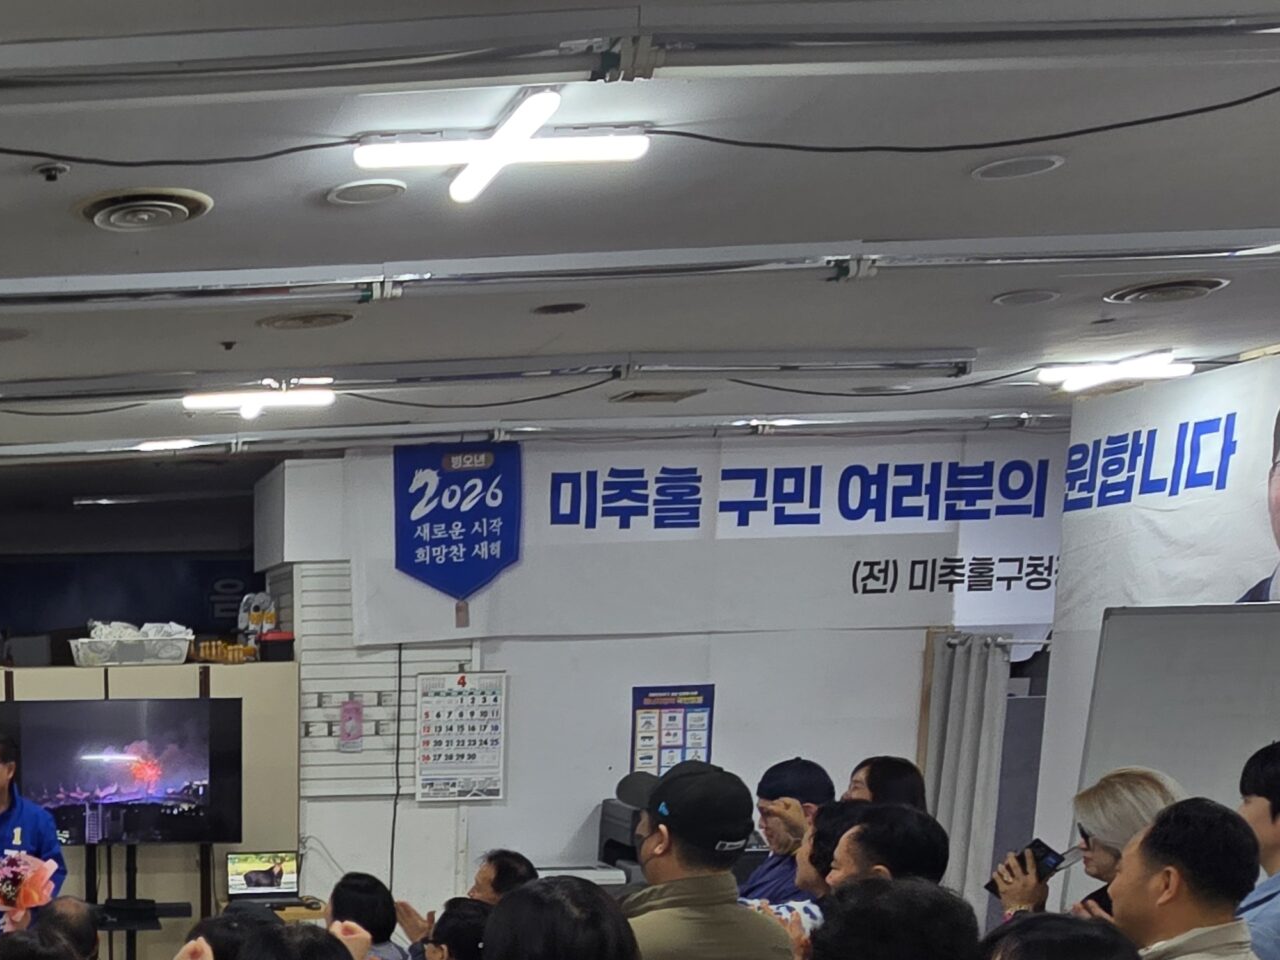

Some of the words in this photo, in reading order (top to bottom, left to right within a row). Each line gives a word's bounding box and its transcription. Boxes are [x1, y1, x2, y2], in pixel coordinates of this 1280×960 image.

[451, 454, 485, 469] 병오년
[408, 468, 503, 520] 2026
[550, 467, 702, 529] 미추홀
[719, 465, 823, 527] 구민
[838, 459, 1050, 522] 여러분의
[414, 521, 466, 542] 새로운
[471, 517, 503, 537] 시작
[414, 543, 466, 565] 희망찬
[472, 540, 502, 560] 새해
[852, 560, 898, 594] (전)
[908, 556, 1058, 592] 미추홀구청
[457, 675, 467, 688] 4
[12, 826, 22, 845] 1
